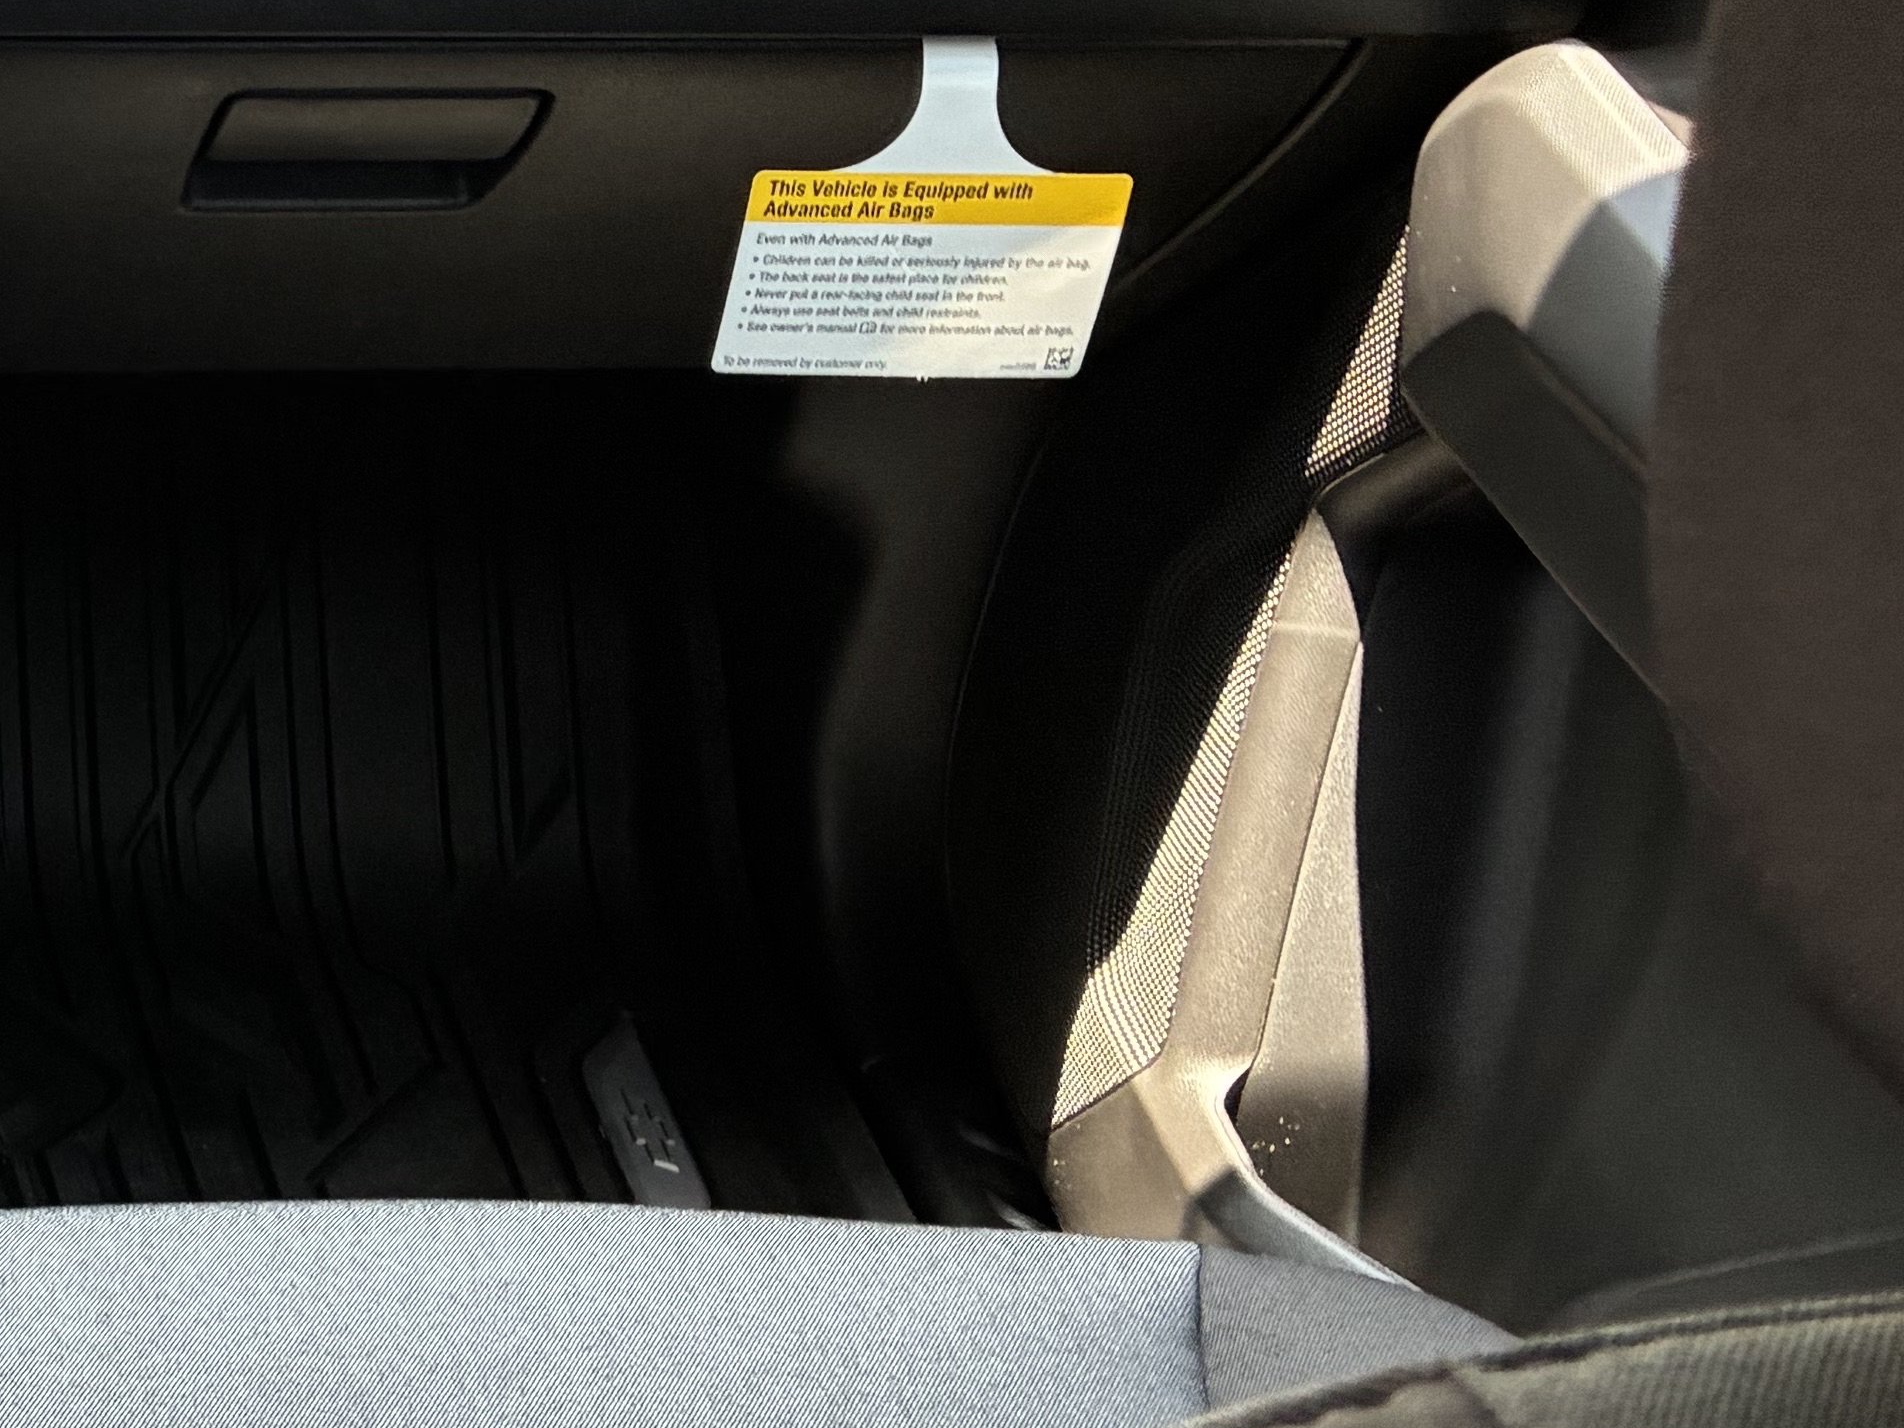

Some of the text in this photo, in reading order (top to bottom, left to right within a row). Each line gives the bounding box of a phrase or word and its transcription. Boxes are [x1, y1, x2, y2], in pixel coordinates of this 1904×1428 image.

[770, 179, 1033, 202] This Vehicle is Equipped with
[763, 200, 935, 222] Advanced Air Bags
[756, 233, 933, 249] Even with Advanced Air Bags
[763, 254, 811, 266] Children
[814, 257, 836, 266] can
[839, 255, 853, 266] be
[856, 255, 889, 267] killed
[892, 258, 905, 267] or
[906, 256, 959, 270] seriously
[963, 256, 1006, 270] injured
[1008, 258, 1022, 270] by
[1025, 257, 1044, 268] the
[1047, 257, 1063, 269] air
